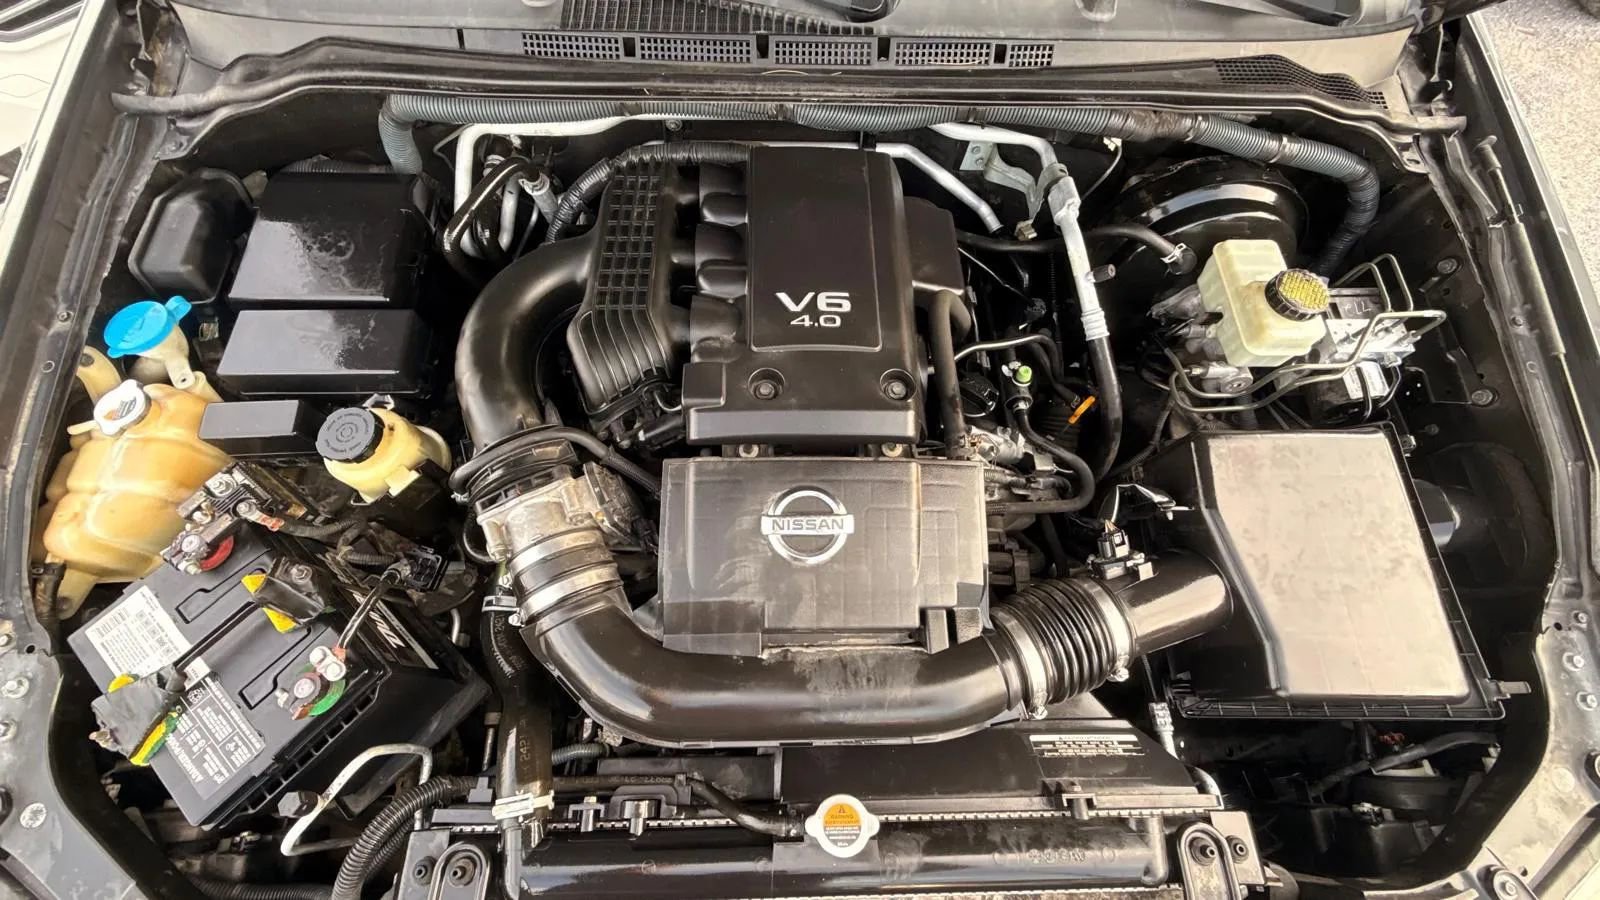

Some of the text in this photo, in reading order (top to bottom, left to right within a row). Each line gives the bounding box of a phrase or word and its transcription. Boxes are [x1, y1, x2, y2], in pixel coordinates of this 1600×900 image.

[776, 291, 851, 312] V6
[790, 314, 841, 327] 4.0
[772, 518, 844, 531] NISSAN
